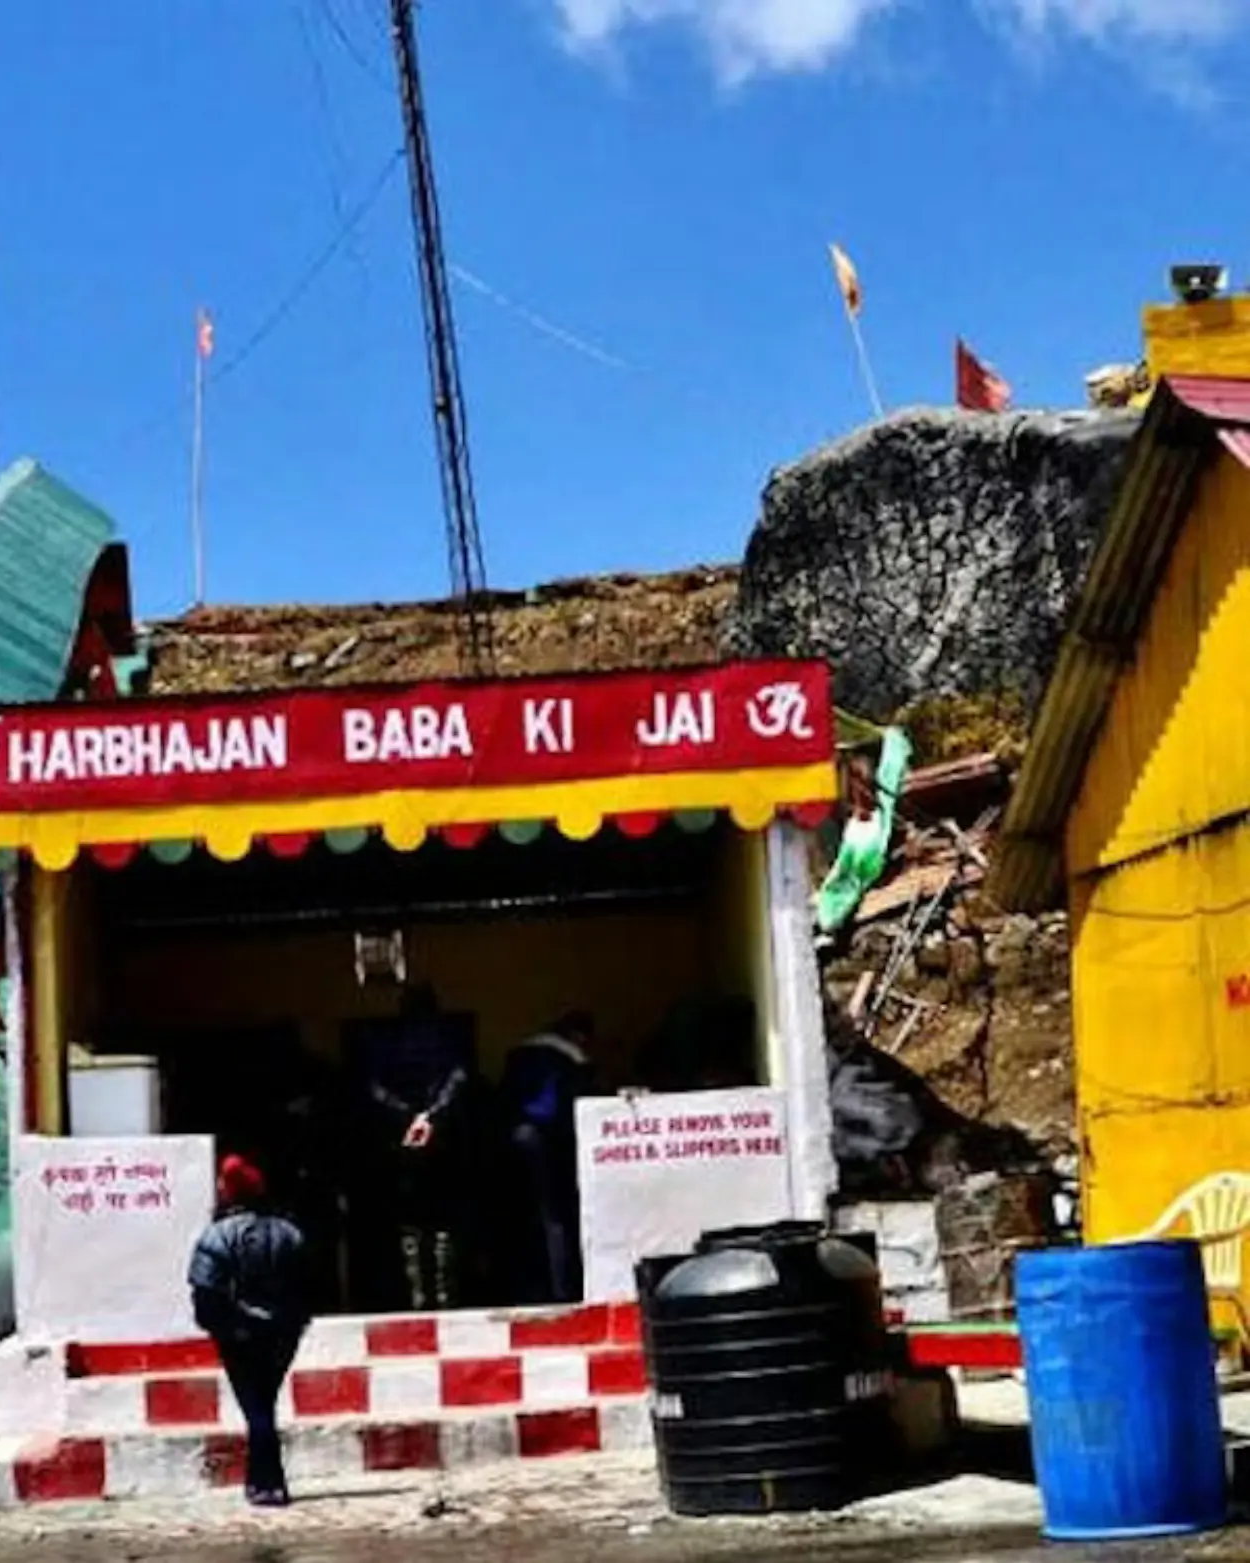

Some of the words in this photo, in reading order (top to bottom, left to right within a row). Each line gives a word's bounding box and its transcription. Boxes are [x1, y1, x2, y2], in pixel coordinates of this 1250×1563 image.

[8, 716, 288, 783] HARBHAJAN
[344, 704, 472, 763] BABA
[524, 700, 574, 754] KI
[638, 691, 715, 746] JAI
[601, 1117, 661, 1138] PLEASE
[745, 1136, 782, 1155] HERE
